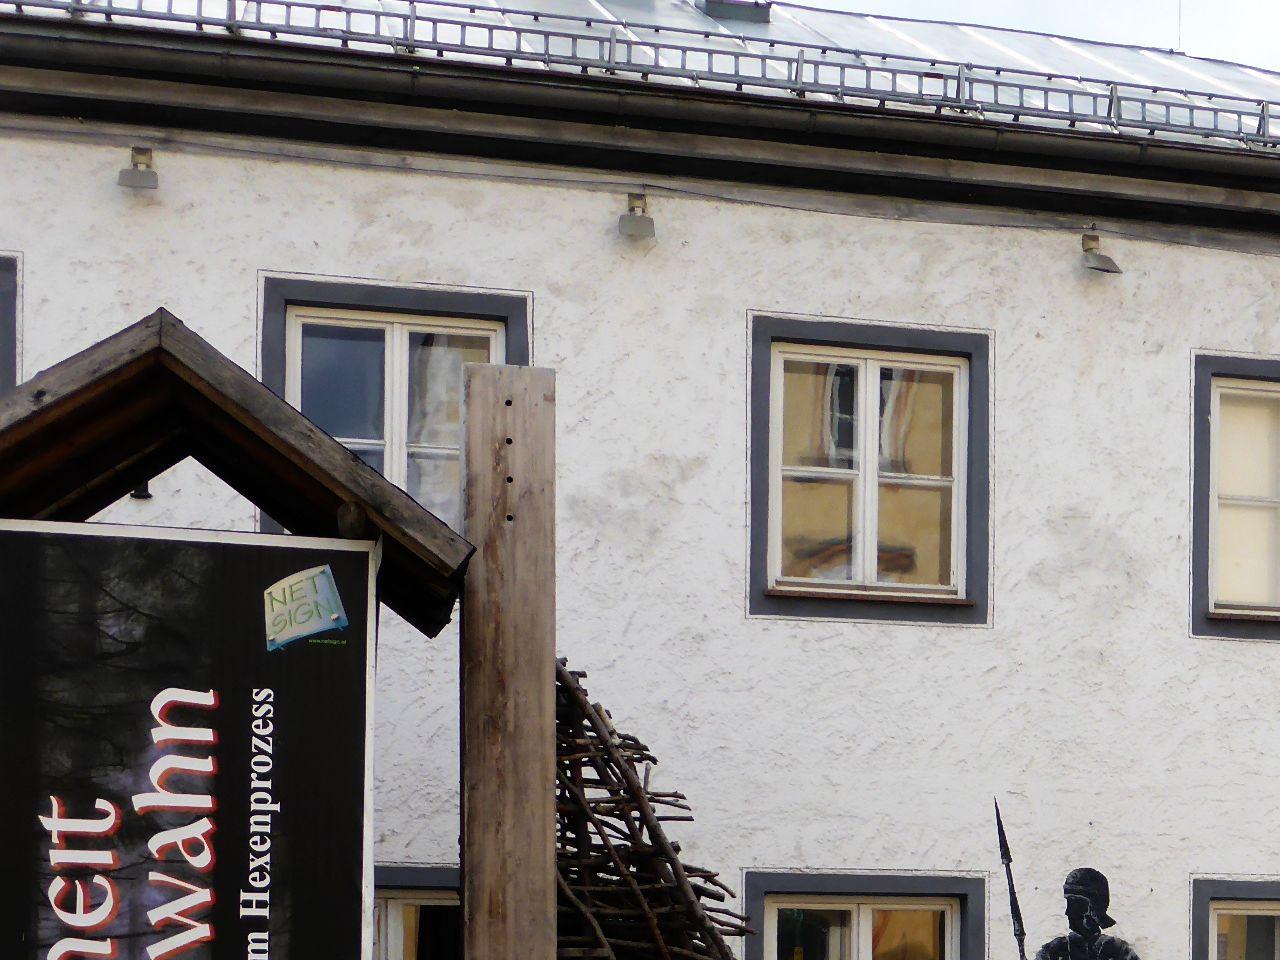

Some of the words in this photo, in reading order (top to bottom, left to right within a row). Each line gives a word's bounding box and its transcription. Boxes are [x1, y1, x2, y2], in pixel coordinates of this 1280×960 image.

[265, 575, 319, 613] NET
[268, 597, 340, 636] SIGN
[239, 687, 281, 920] Hexenprozess
